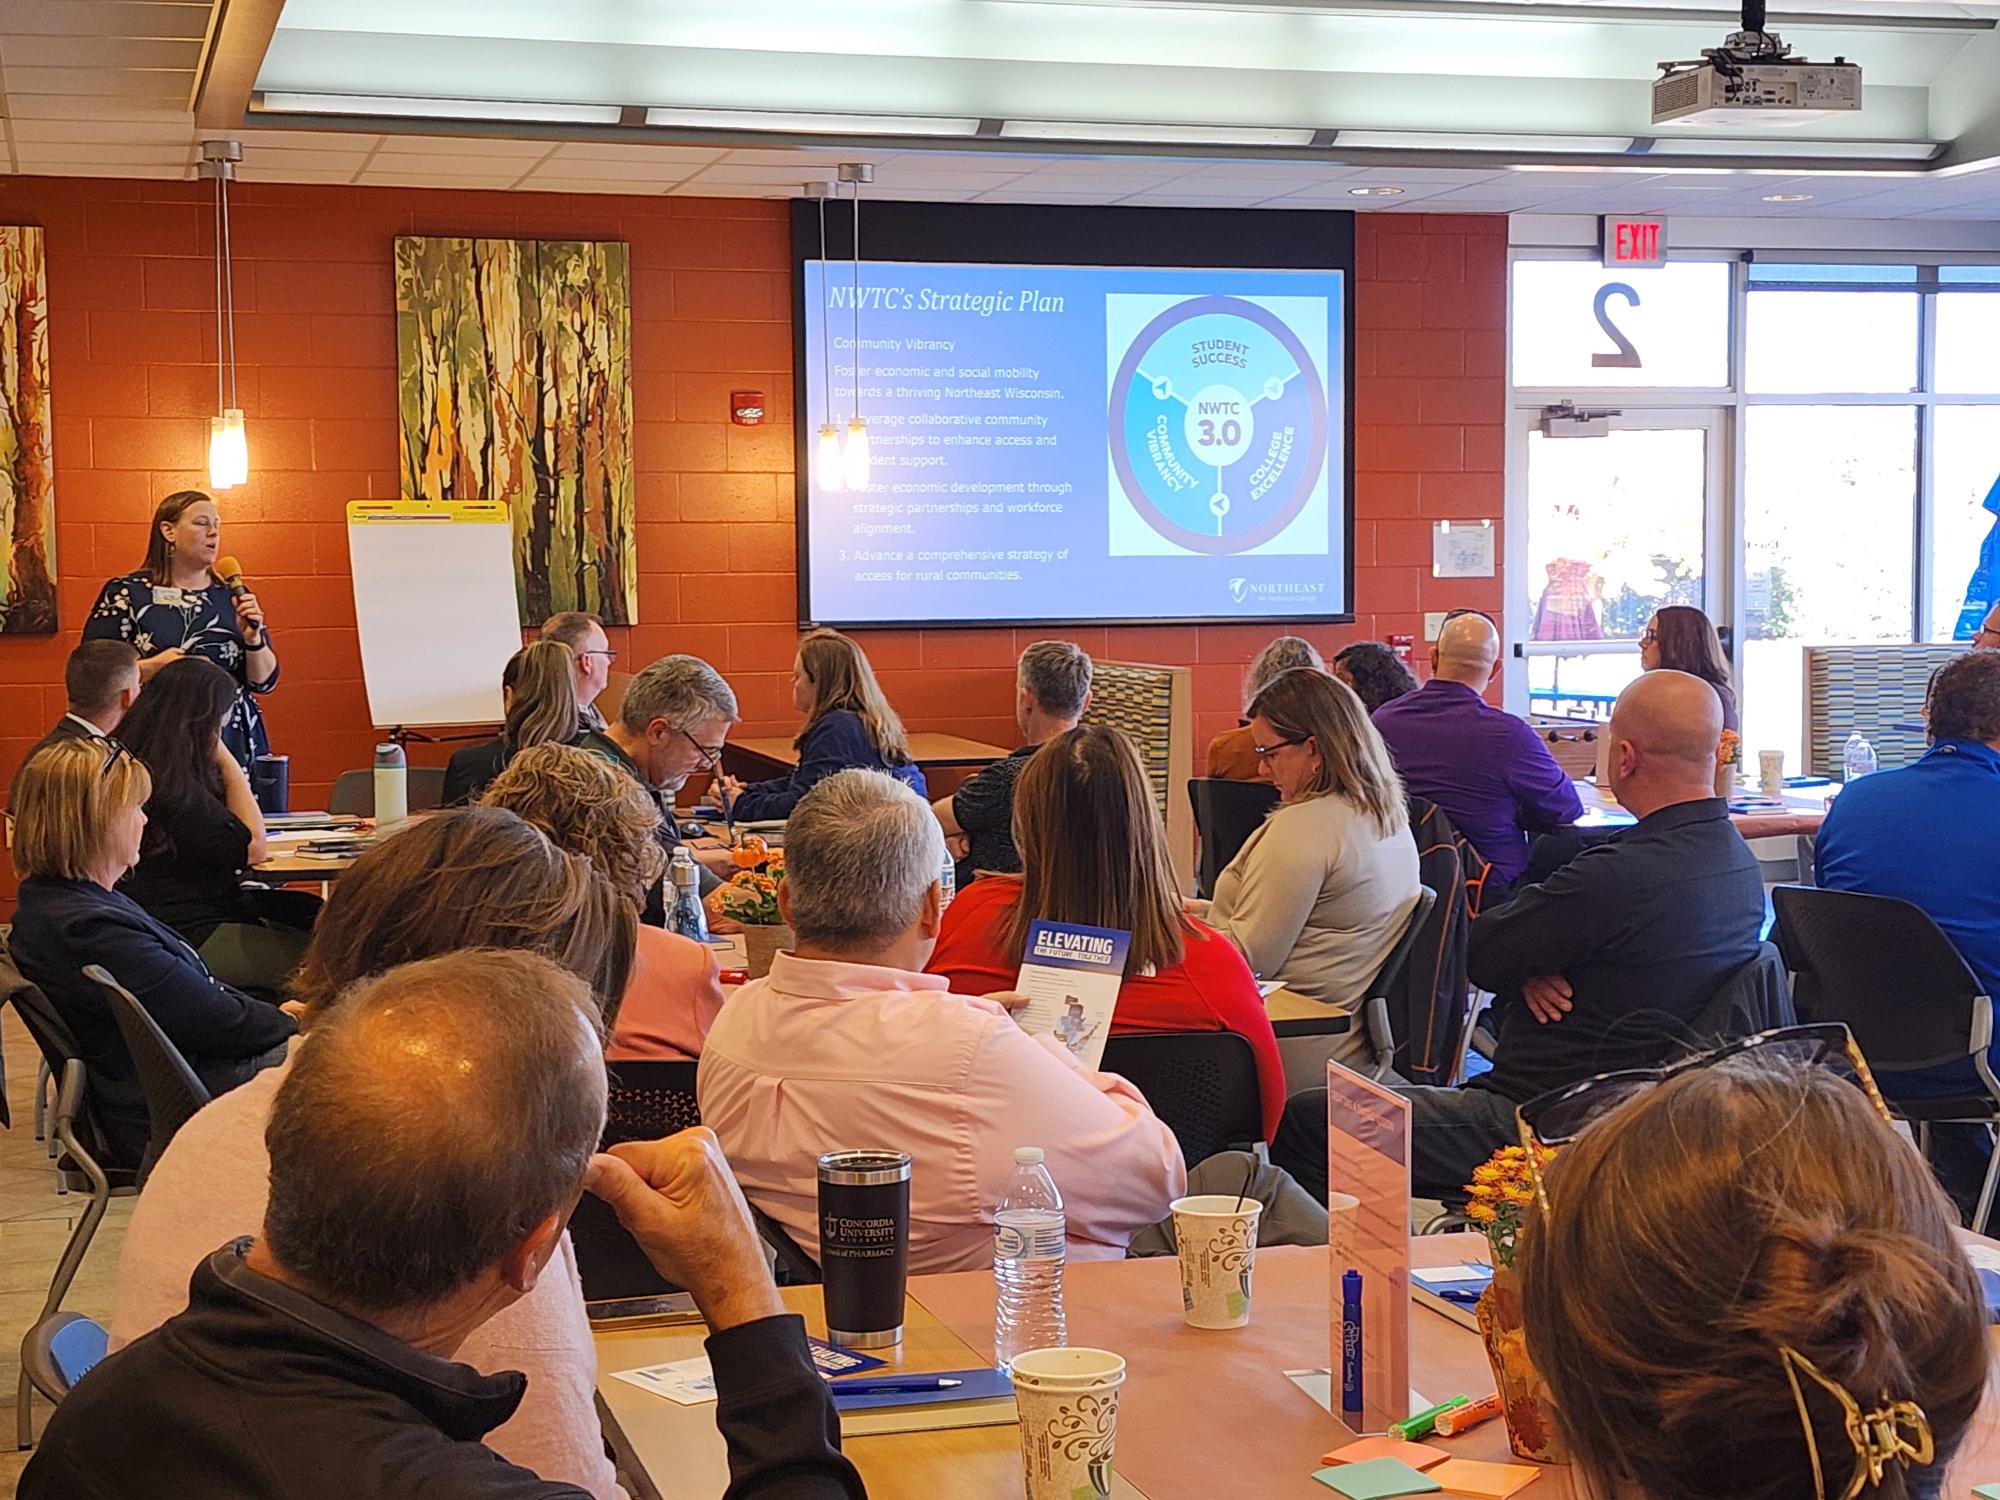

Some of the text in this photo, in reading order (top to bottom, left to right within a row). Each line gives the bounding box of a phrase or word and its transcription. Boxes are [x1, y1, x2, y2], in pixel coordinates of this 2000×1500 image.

[1616, 223, 1661, 261] EXIT
[828, 286, 1065, 317] NWTC's Strategic Plan
[833, 336, 956, 352] Community Vibrancy
[1191, 339, 1250, 356] STUDENT
[1191, 352, 1248, 369] SUCCESS
[834, 365, 1040, 381] Foster economic and social mobility
[834, 386, 1065, 401] towards a thriving Northeast Wisconsin.
[1198, 402, 1240, 416] NWTC
[853, 415, 904, 429] verage
[908, 414, 982, 426] collaborative
[985, 414, 1049, 429] community
[1197, 419, 1242, 447] 3.0
[867, 435, 1057, 449] rtnerships to enhance access and
[1157, 415, 1199, 489] COMMUNITY
[1249, 431, 1283, 485] COLLEGE
[869, 454, 948, 470] dent support.
[1146, 429, 1184, 493] VIBRANCY
[1250, 426, 1295, 501] EXCELLENCE
[892, 481, 948, 494] economic
[951, 481, 1024, 496] development
[1027, 481, 1073, 495] through
[853, 501, 1063, 516] strategic partnerships and workforce
[853, 523, 916, 537] alignment.
[838, 548, 1070, 564] 3. Advance a comprehensive strategy of
[854, 570, 1024, 582] access for rural communities.
[1250, 583, 1325, 593] NORTHEAST
[1037, 930, 1114, 955] ELEVATING
[840, 1218, 895, 1229] CONCORDIA
[840, 1227, 895, 1238] UNIVERSITY
[848, 1249, 896, 1259] PHARMACY
